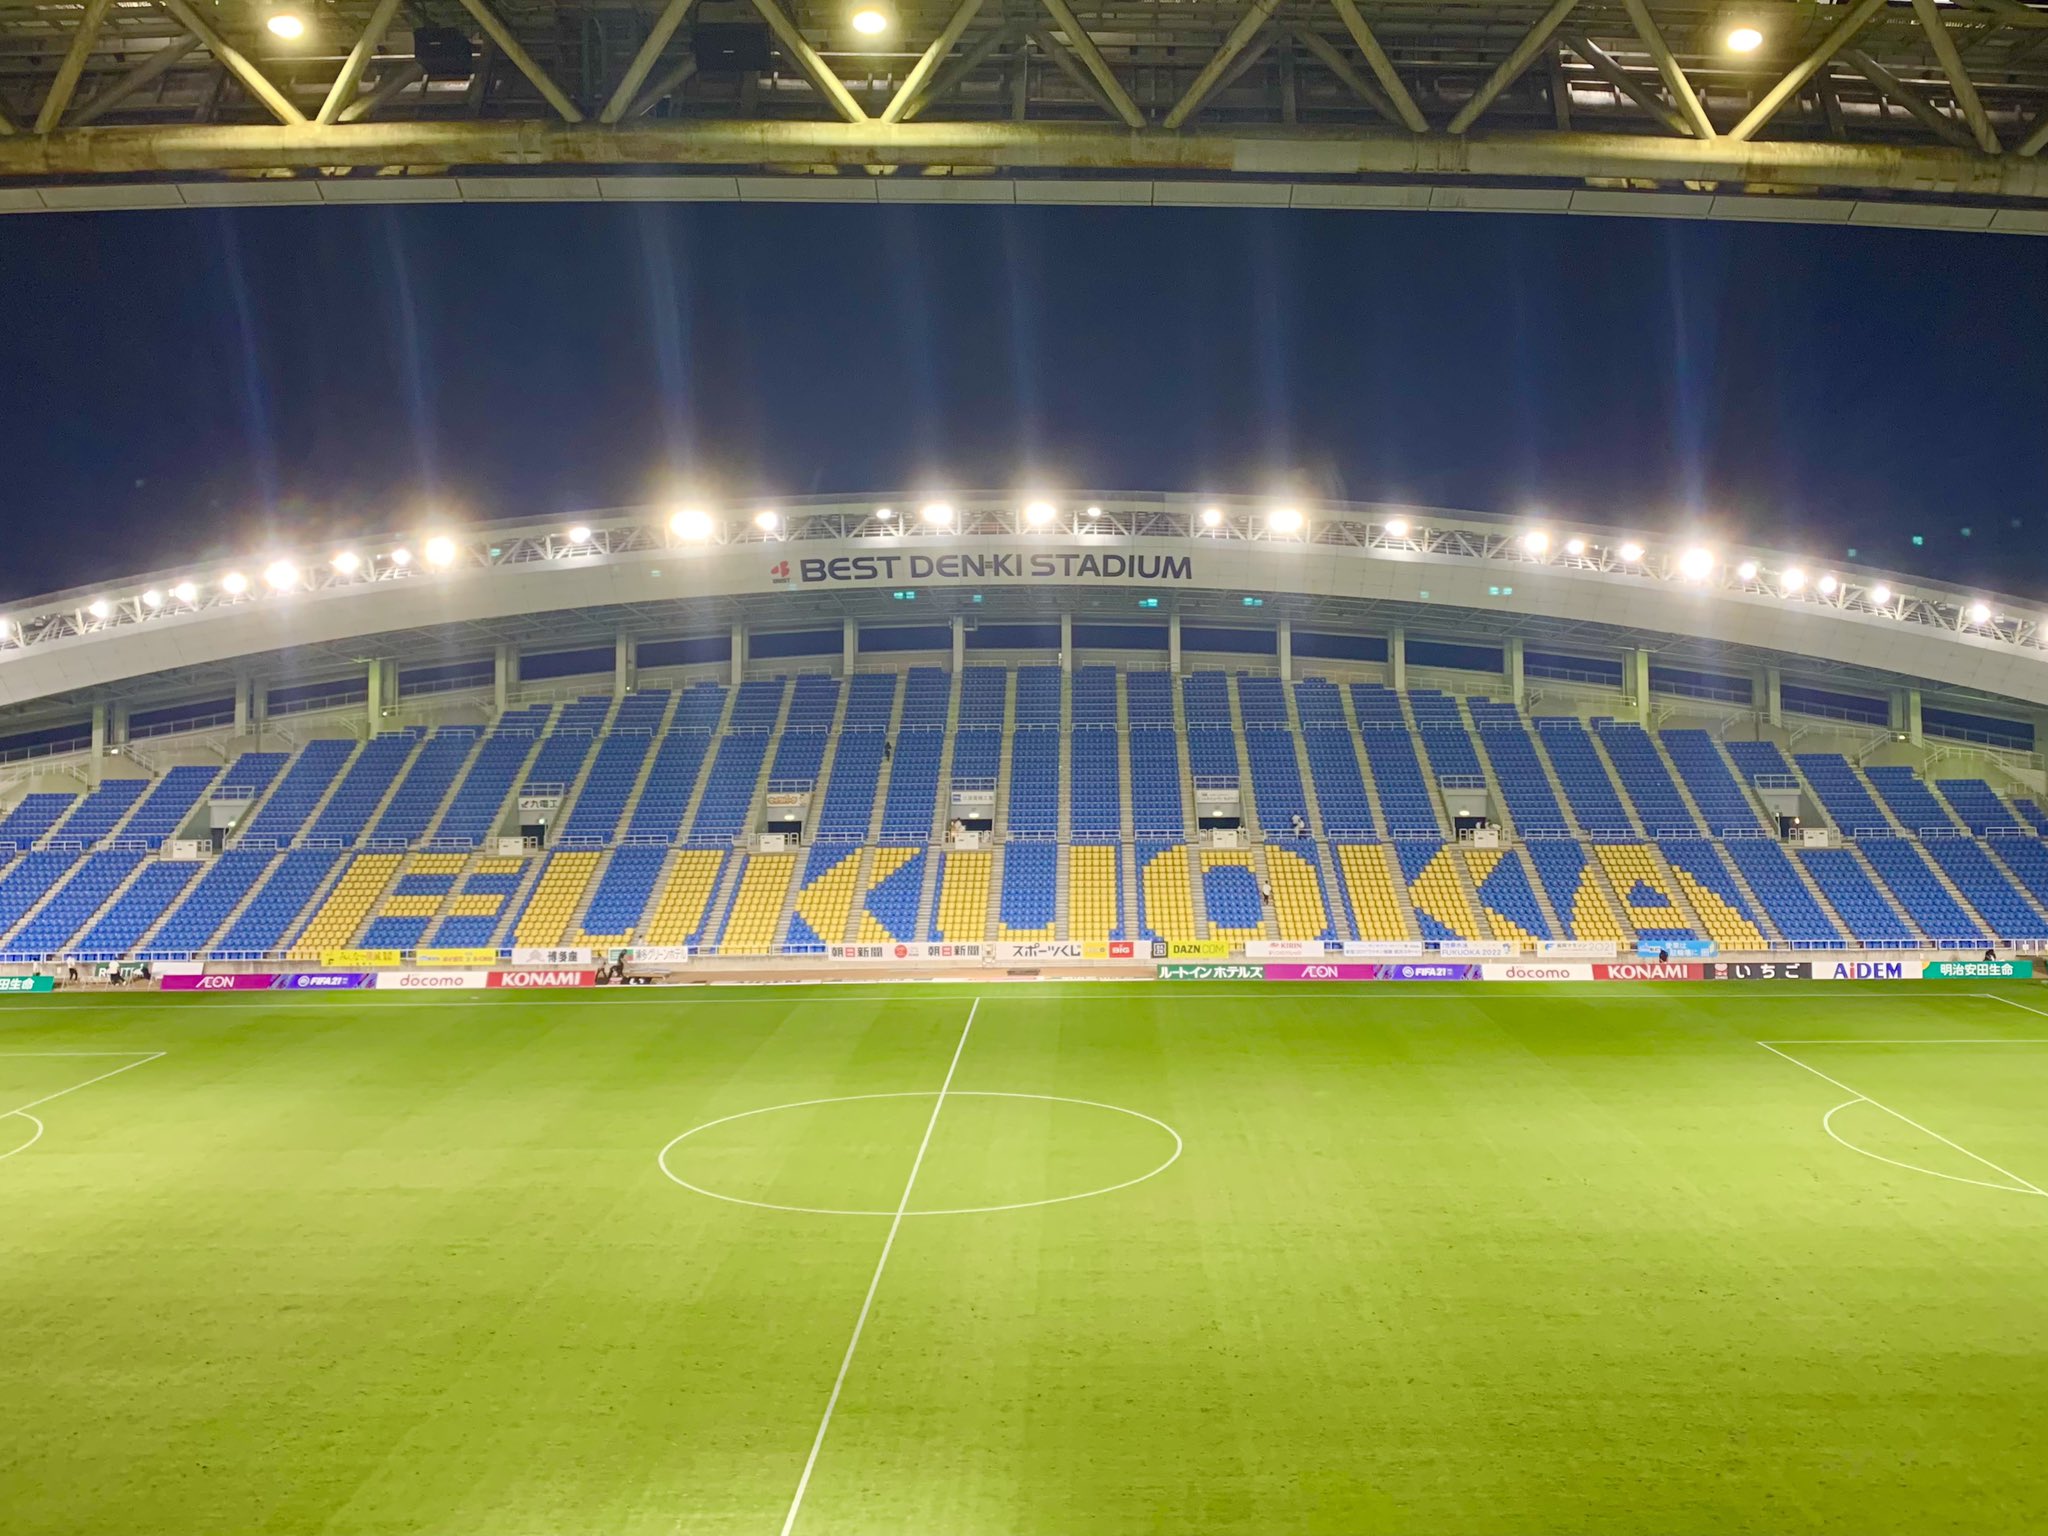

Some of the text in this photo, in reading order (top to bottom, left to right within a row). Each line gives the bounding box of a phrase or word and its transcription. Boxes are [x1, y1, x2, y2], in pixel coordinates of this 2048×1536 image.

[800, 555, 901, 582] BEST
[1030, 553, 1193, 579] STADIUM
[831, 946, 883, 958] 朝日新聞
[928, 945, 979, 957] 朝日新聞
[1012, 942, 1081, 957] スポーツくじ
[1506, 967, 1570, 978] docomo
[1608, 965, 1688, 979] KONAMI
[1735, 964, 1800, 979] いちご
[1940, 963, 2014, 976] 明治安田生命
[400, 974, 464, 986] docomo
[501, 972, 581, 986] KONAMI
